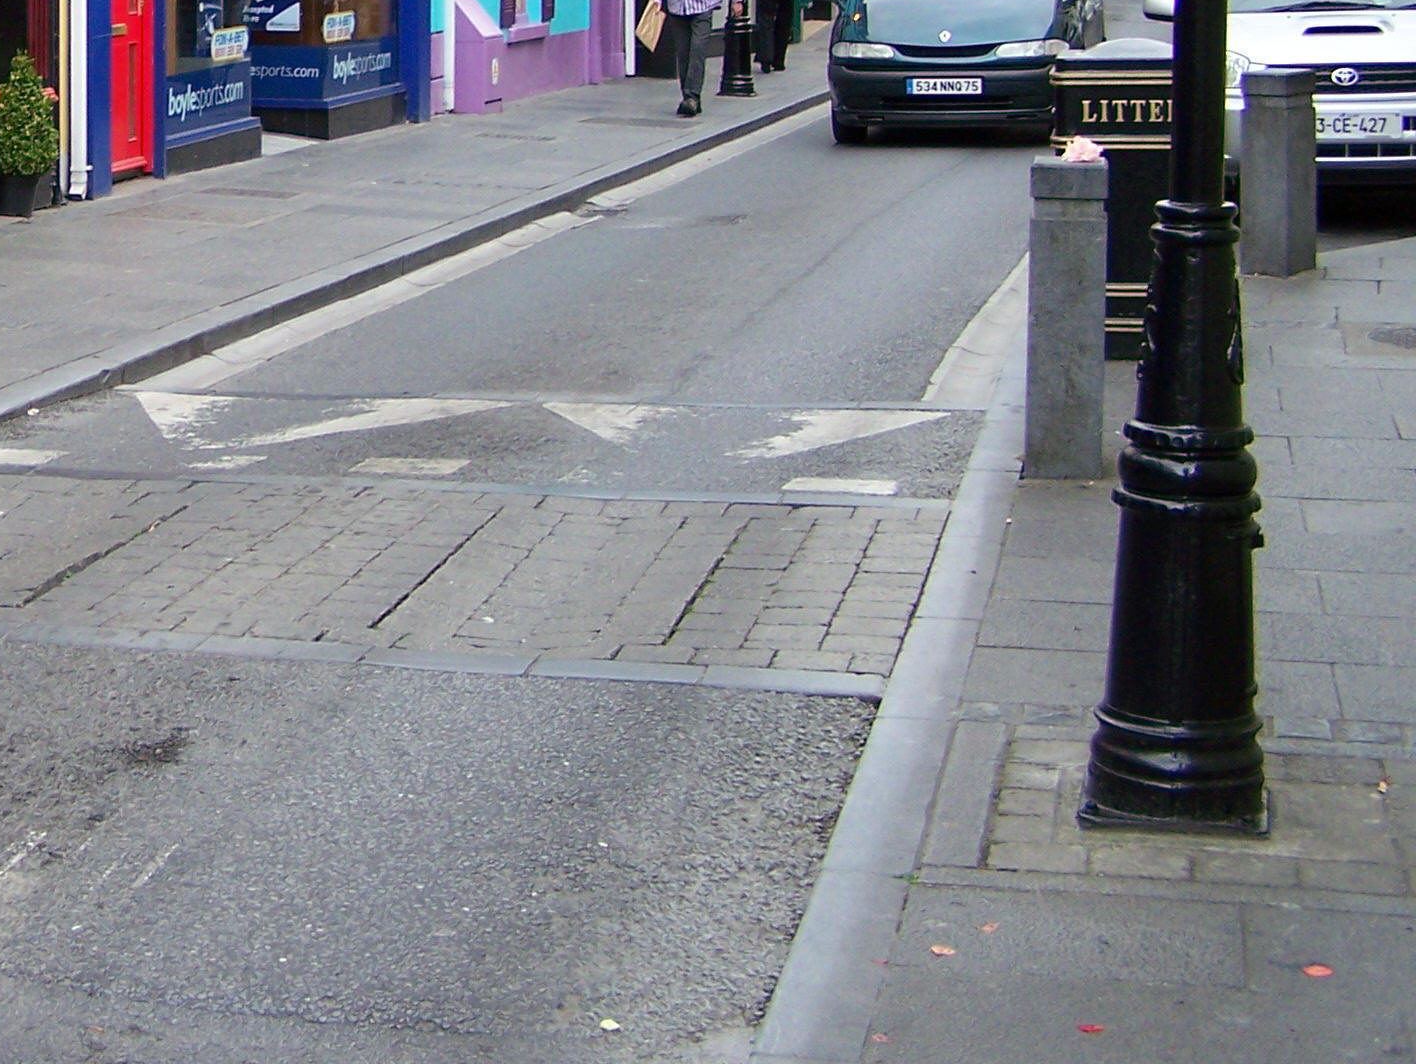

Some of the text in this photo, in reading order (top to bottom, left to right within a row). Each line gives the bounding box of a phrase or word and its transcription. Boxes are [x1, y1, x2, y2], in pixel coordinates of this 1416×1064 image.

[333, 52, 392, 85] boylesports.com
[167, 81, 244, 122] boylesports.com
[915, 80, 938, 92] 534
[963, 80, 979, 92] 75
